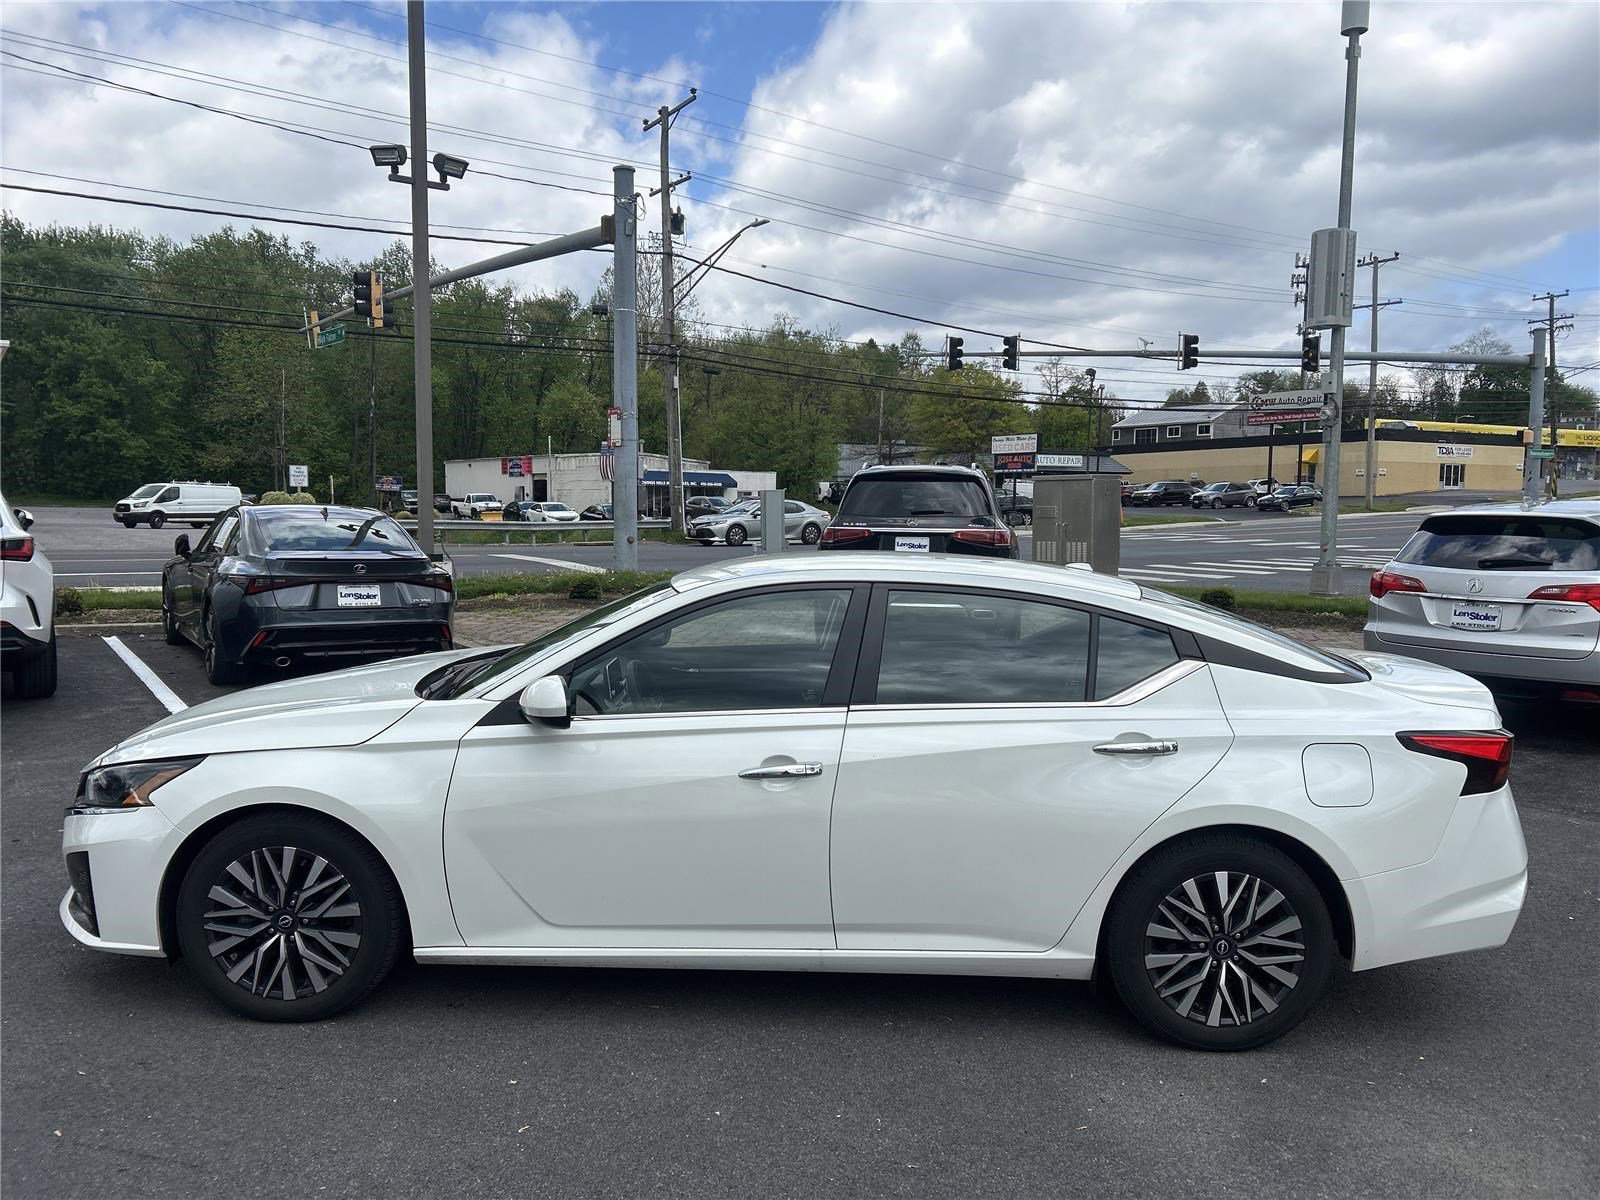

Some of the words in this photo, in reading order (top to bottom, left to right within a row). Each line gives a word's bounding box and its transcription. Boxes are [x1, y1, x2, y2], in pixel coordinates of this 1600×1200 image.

[1297, 395, 1322, 404] Repair
[993, 443, 1013, 452] USED
[1014, 442, 1035, 451] CARS
[1036, 456, 1055, 465] AUTO
[1057, 457, 1082, 465] REPAIR
[1453, 609, 1498, 622] LenStoler
